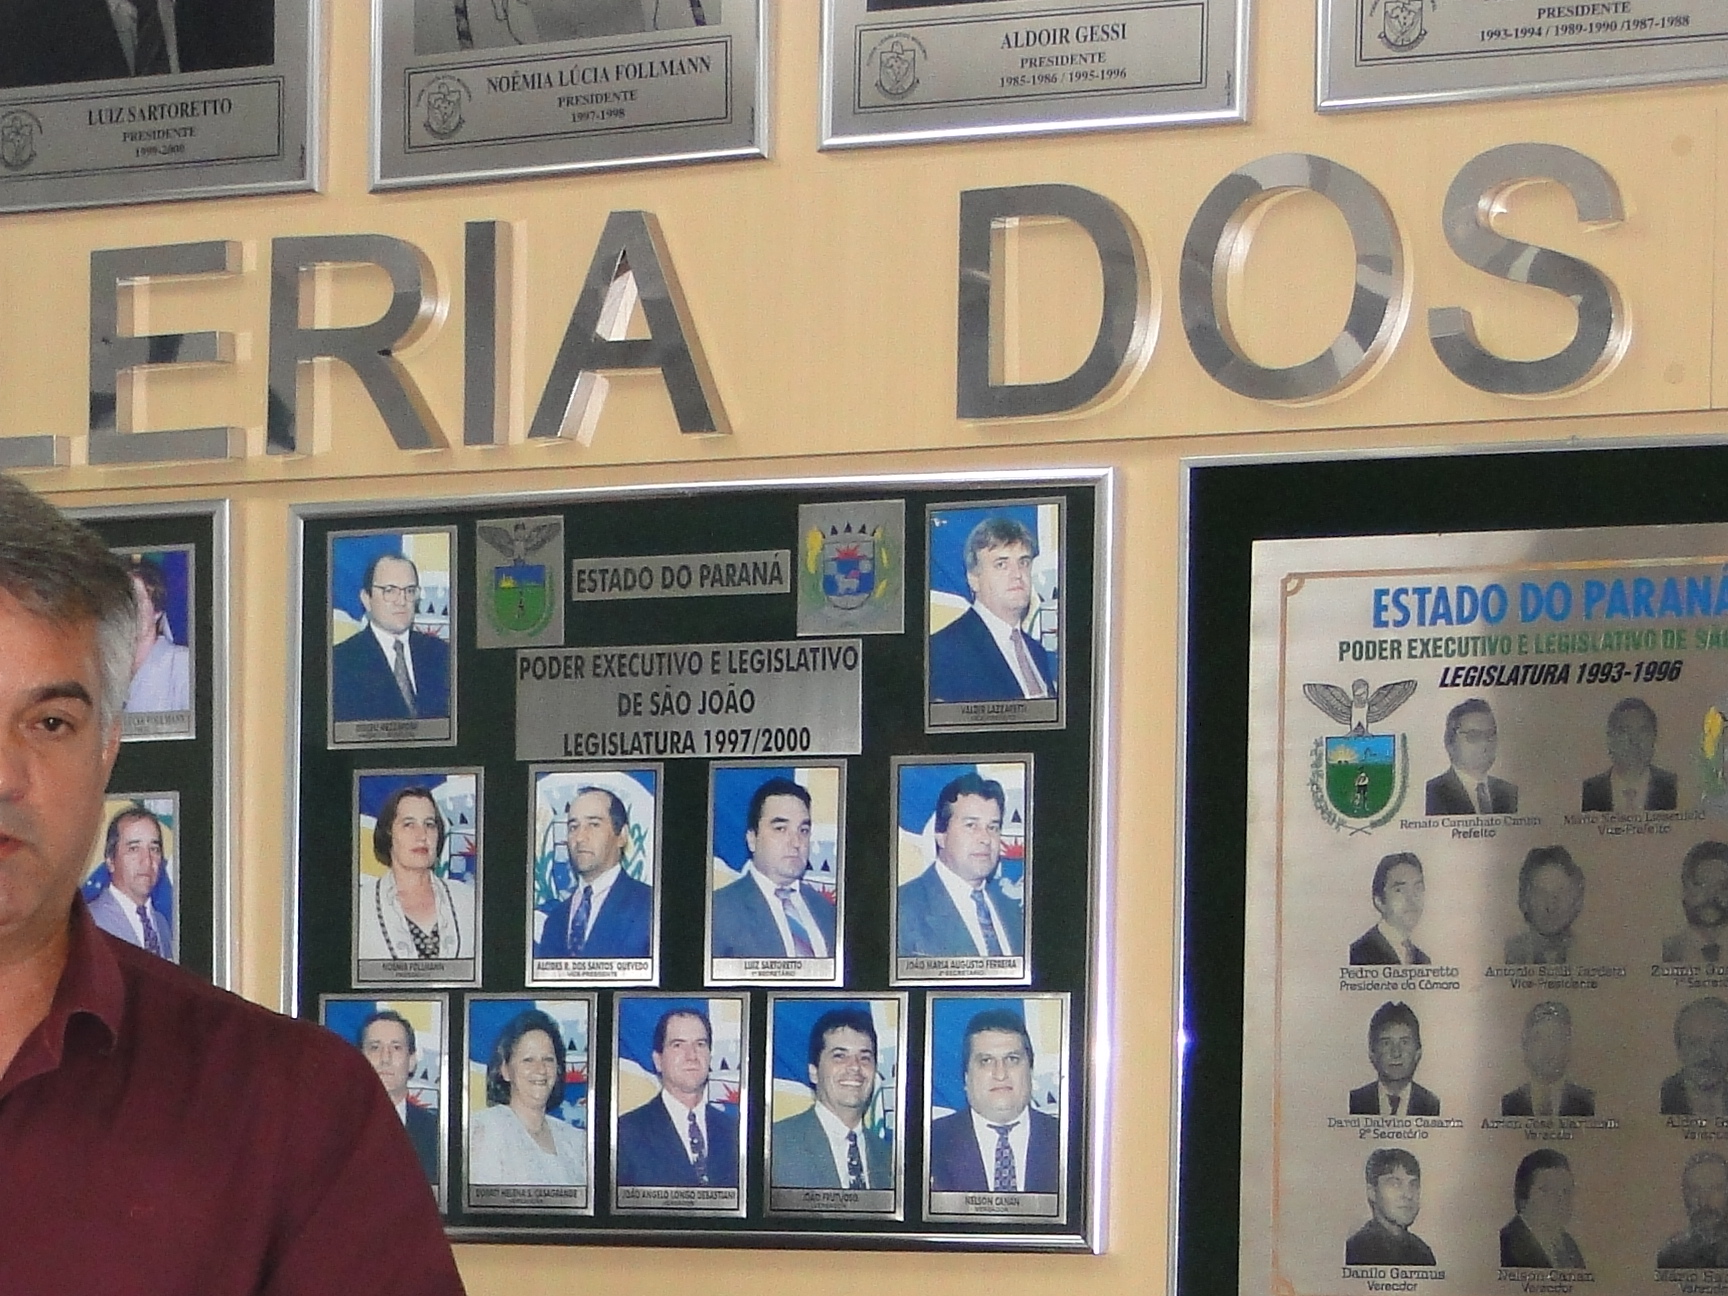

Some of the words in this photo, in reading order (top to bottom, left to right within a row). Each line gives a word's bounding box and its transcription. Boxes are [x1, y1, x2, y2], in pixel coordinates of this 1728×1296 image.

[1536, 1, 1632, 20] PRESIDENTE
[1000, 29, 1071, 51] ALDOIR
[1074, 23, 1129, 46] GESSI
[1480, 25, 1543, 43] 1993-1994
[1553, 19, 1619, 38] 1989-1990
[1019, 52, 1108, 70] PRESIDENTE
[557, 62, 611, 87] LÚCIA
[614, 55, 712, 82] FOLLMANN
[999, 71, 1059, 88] 1985-1986
[1068, 67, 1129, 84] 1995-1996
[558, 89, 639, 108] PRESIDENTE
[88, 106, 125, 127] LUIZ
[126, 97, 233, 123] SARTORETTO
[571, 108, 626, 123] 1997-1998
[122, 126, 197, 143] PRESIDENTE
[955, 142, 1634, 420] DOS
[576, 563, 654, 595] ESTADO
[660, 560, 692, 592] DO
[699, 552, 784, 590] PARANÁ
[1372, 582, 1509, 629] ESTADO
[1519, 579, 1573, 624] DO
[1337, 637, 1402, 662] PODER
[1406, 633, 1513, 660] EXECUTIVO
[1517, 634, 1528, 656] E
[1533, 629, 1655, 656] LEGISLATIVO
[1660, 628, 1687, 651] DE
[519, 654, 586, 682] PODER
[592, 650, 703, 680] EXECUTIVO
[710, 649, 722, 676] E
[727, 645, 859, 675] LEGISLATIVO
[1438, 665, 1571, 689] LEGISLATURA
[1574, 658, 1684, 684] 1993-1996
[617, 692, 643, 718] DE
[649, 684, 691, 717] SÃO
[697, 683, 756, 716] JOÃO
[562, 731, 697, 759] LEGISLATURA
[702, 726, 812, 755] 1997/2000
[1399, 819, 1440, 830] Renato
[1451, 829, 1497, 840] Prefeito
[587, 961, 614, 971] SANTOS
[616, 961, 649, 971] QUEVEDO
[744, 960, 760, 971] LUIZ
[1339, 966, 1379, 980] Pedro
[1381, 966, 1460, 981] Gasparetto
[1339, 980, 1399, 991] Presidente
[1363, 1117, 1412, 1128] Dalvino
[1414, 1117, 1464, 1129] Casarin
[1372, 1128, 1430, 1140] Secretário
[1341, 1267, 1386, 1279] Danilo
[1389, 1267, 1446, 1280] Garmus
[1367, 1280, 1419, 1292] Vereador
